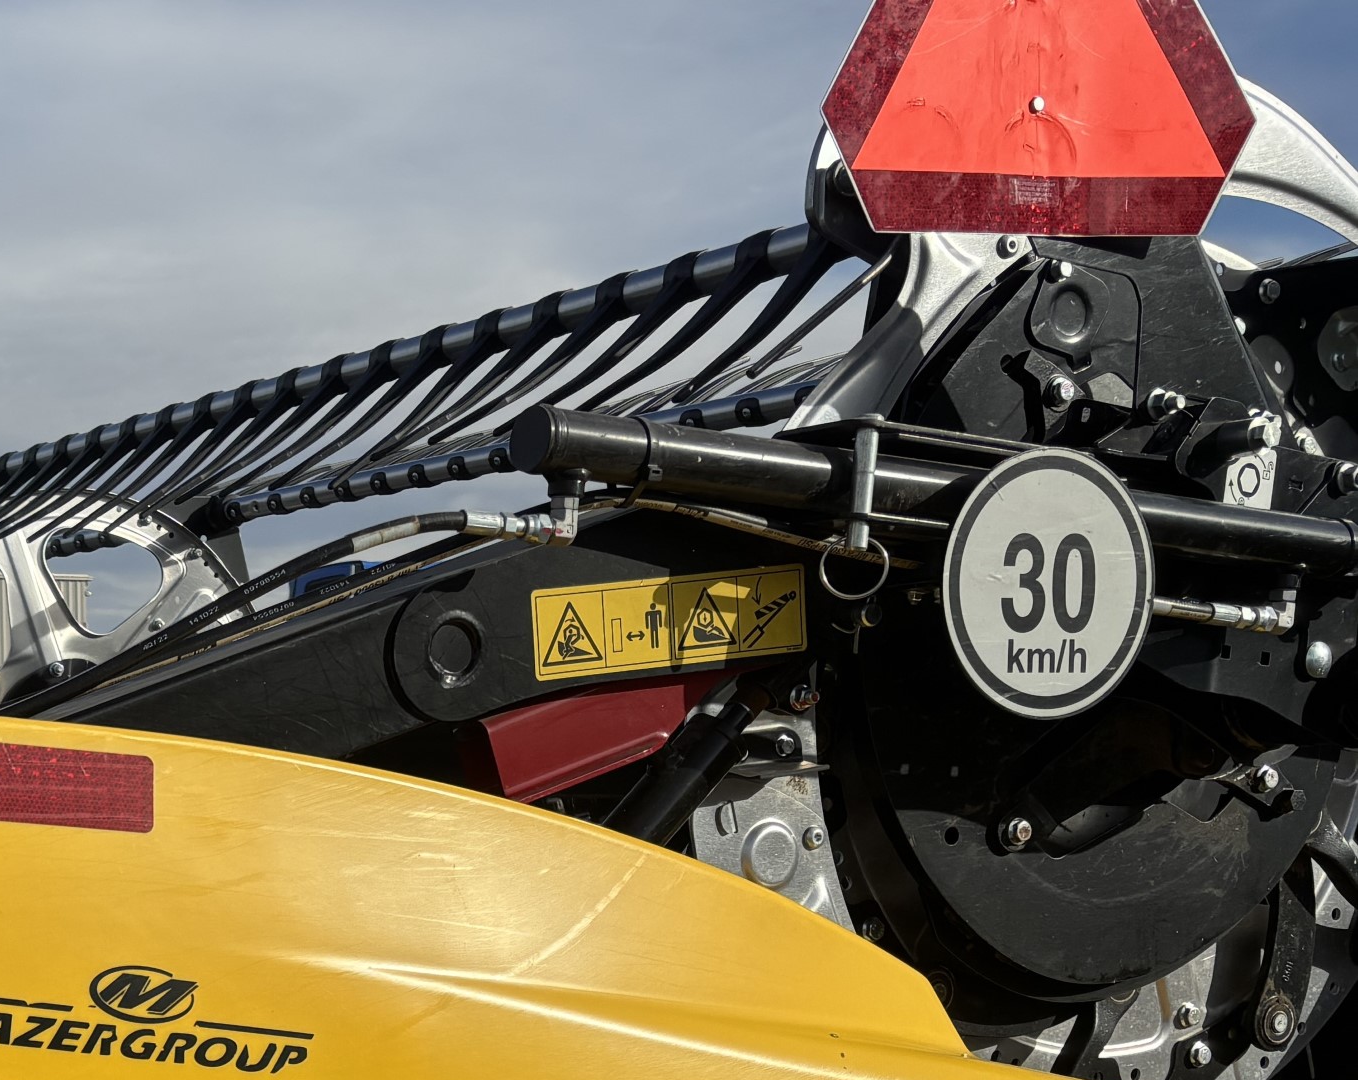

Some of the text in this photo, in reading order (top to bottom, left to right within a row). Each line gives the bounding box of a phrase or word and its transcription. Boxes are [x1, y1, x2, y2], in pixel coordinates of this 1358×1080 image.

[1001, 533, 1096, 633] 30
[1007, 639, 1087, 674] km/h
[99, 972, 199, 1016] M
